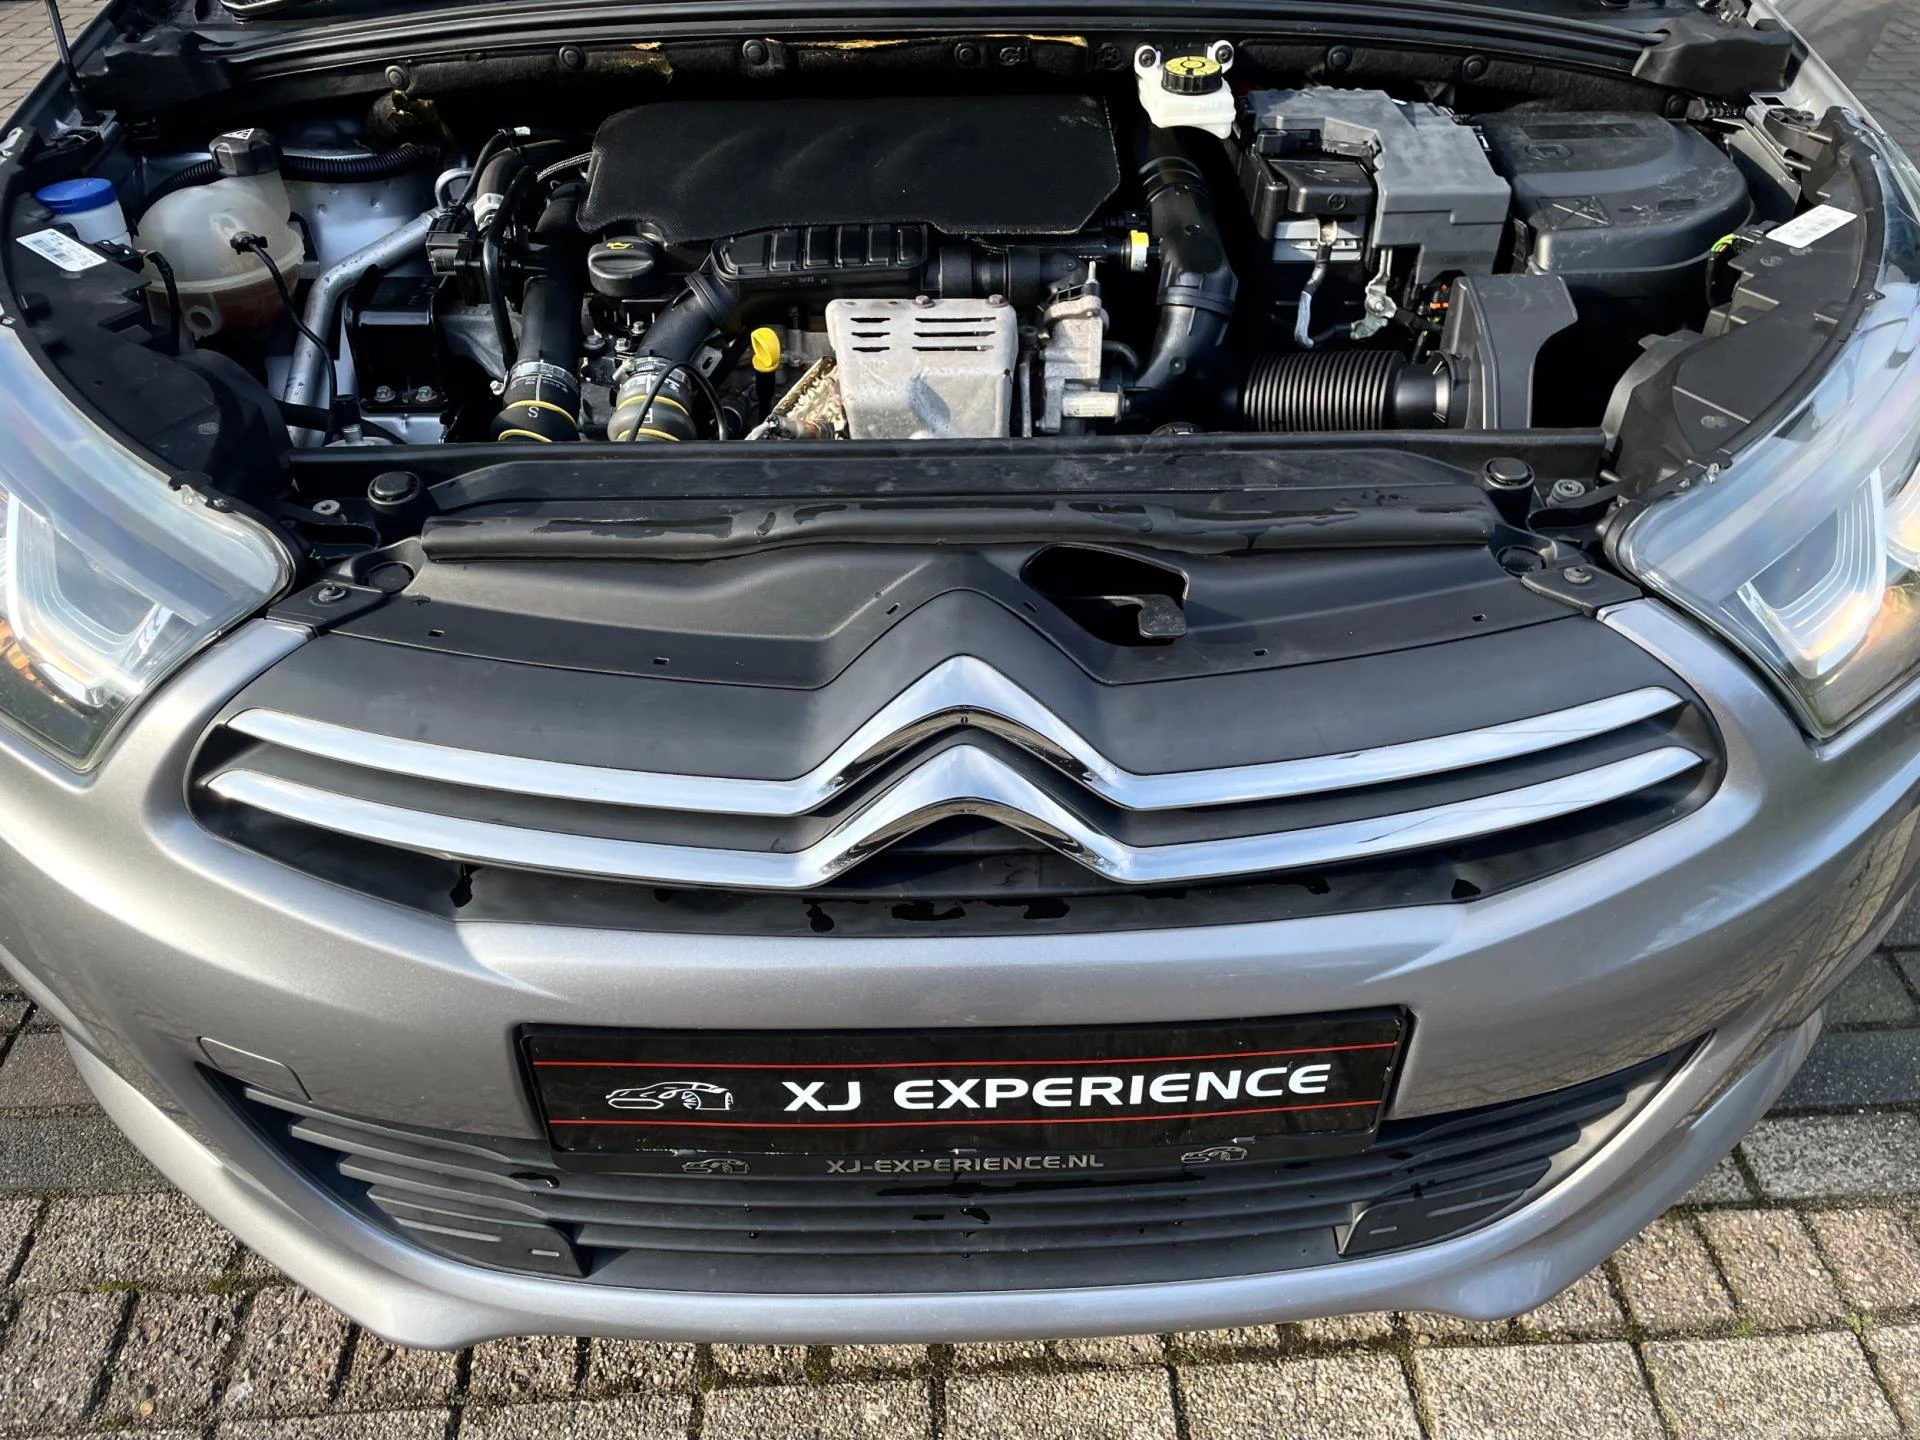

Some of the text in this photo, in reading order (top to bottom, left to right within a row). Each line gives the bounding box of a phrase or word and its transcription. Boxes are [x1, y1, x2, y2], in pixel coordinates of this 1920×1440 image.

[527, 406, 540, 418] S
[782, 1063, 1331, 1112] XJ EXPERIENCE
[826, 1154, 1104, 1174] XJ-EXPERIENCE.NL
